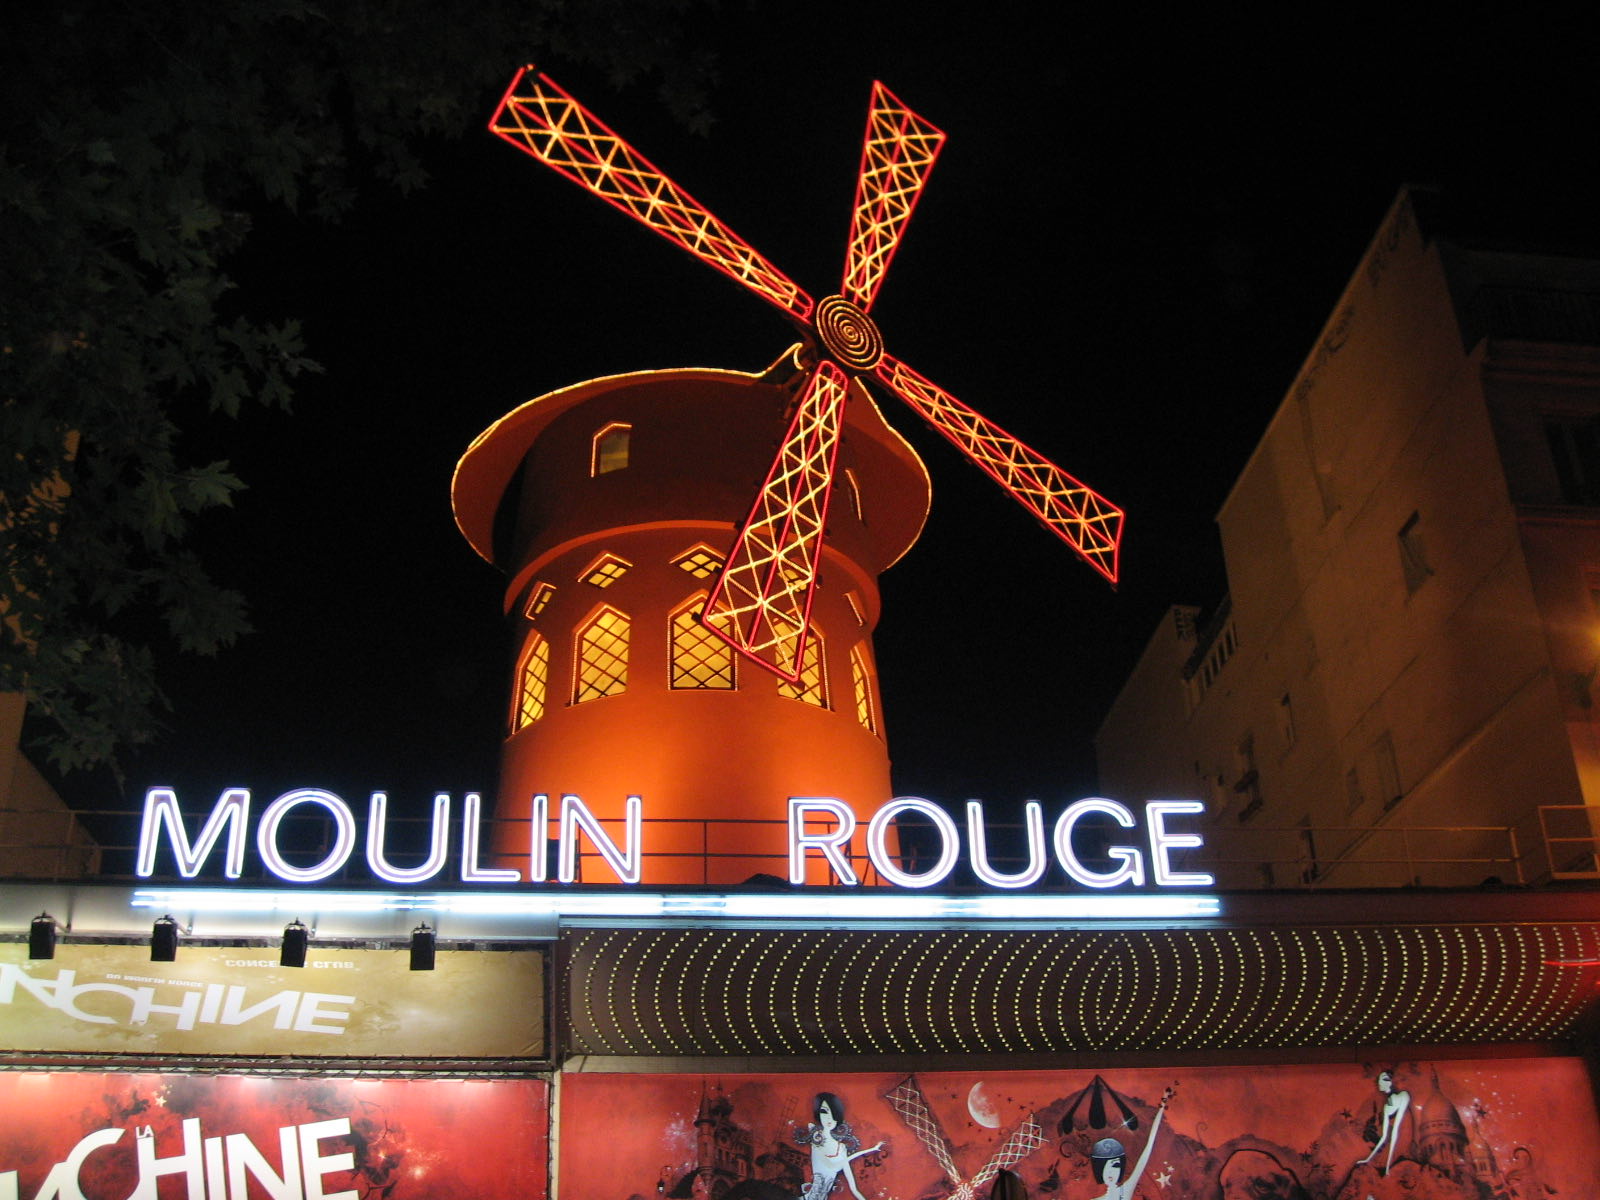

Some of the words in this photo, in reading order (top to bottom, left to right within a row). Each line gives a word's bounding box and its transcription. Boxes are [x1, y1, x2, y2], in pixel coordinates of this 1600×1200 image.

[136, 786, 643, 885] MOULIN
[787, 796, 1215, 888] ROUGE
[0, 1117, 359, 1200] CHINE
[135, 1124, 155, 1139] LA
